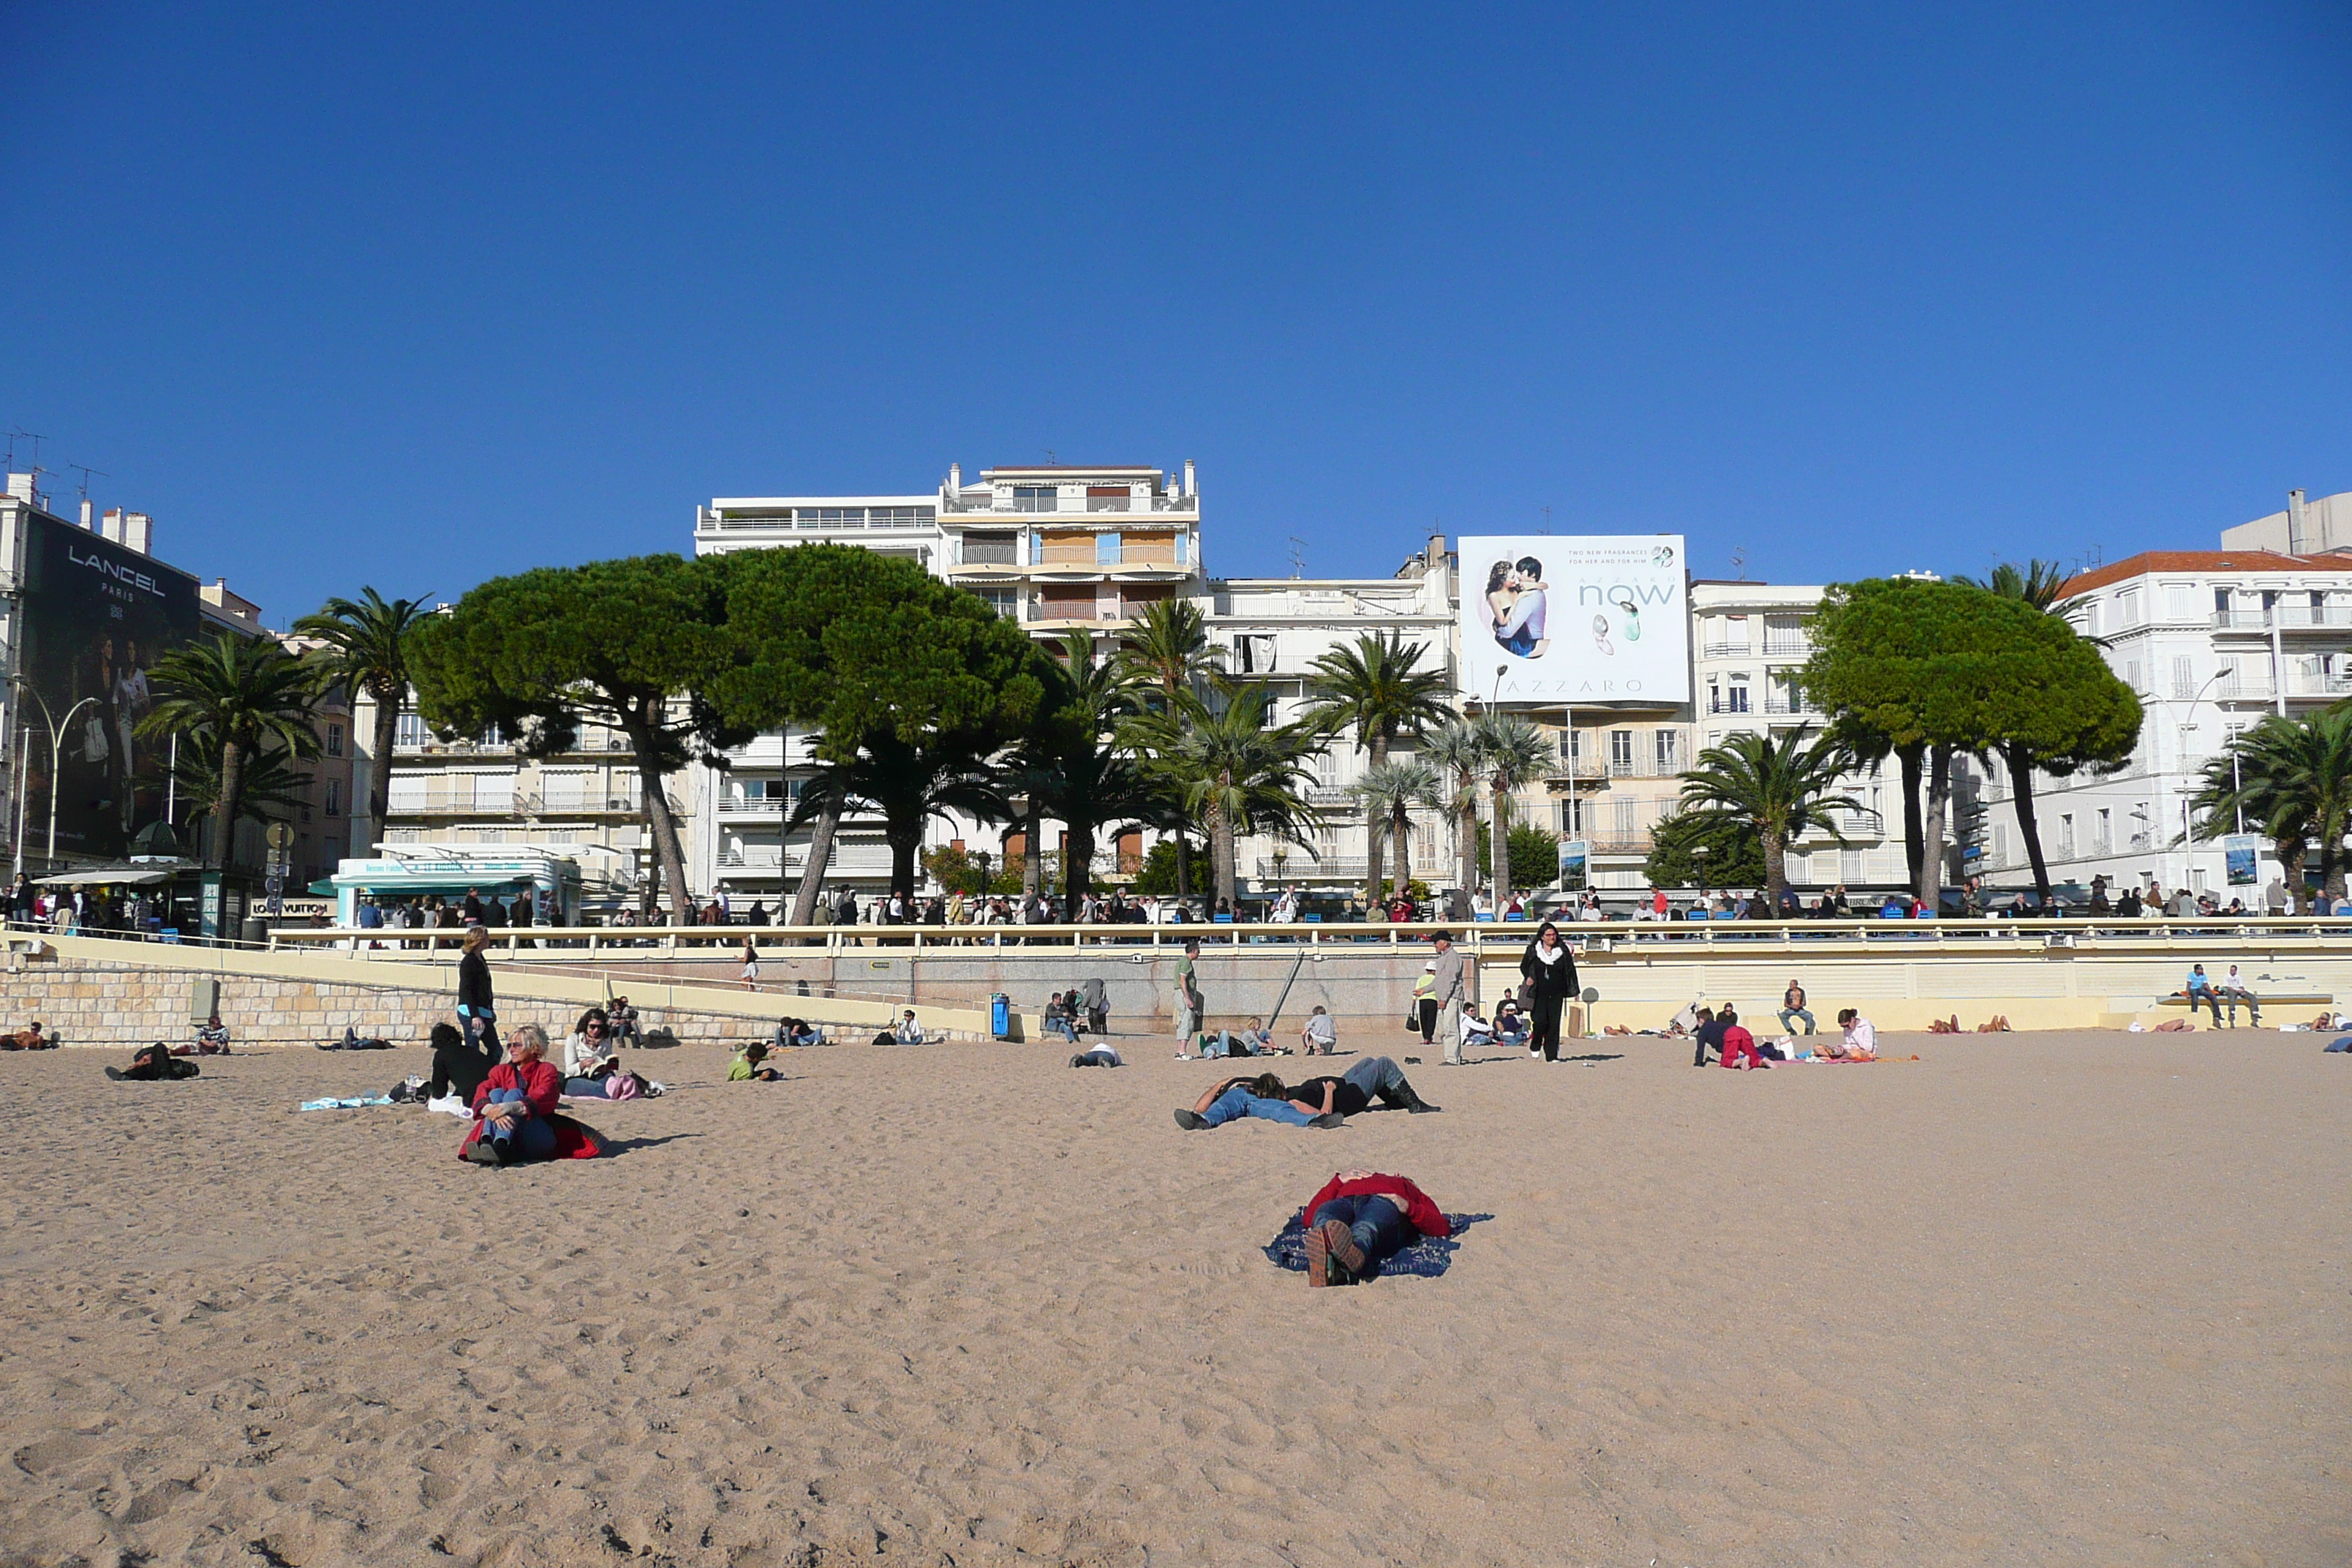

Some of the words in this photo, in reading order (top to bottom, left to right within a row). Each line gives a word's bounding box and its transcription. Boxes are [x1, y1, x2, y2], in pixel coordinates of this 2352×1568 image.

[69, 545, 165, 598] LANCEL
[102, 582, 133, 603] PARIS
[1579, 584, 1676, 606] now
[1507, 679, 1642, 693] AZZARO
[1849, 898, 1888, 906] BRUNO
